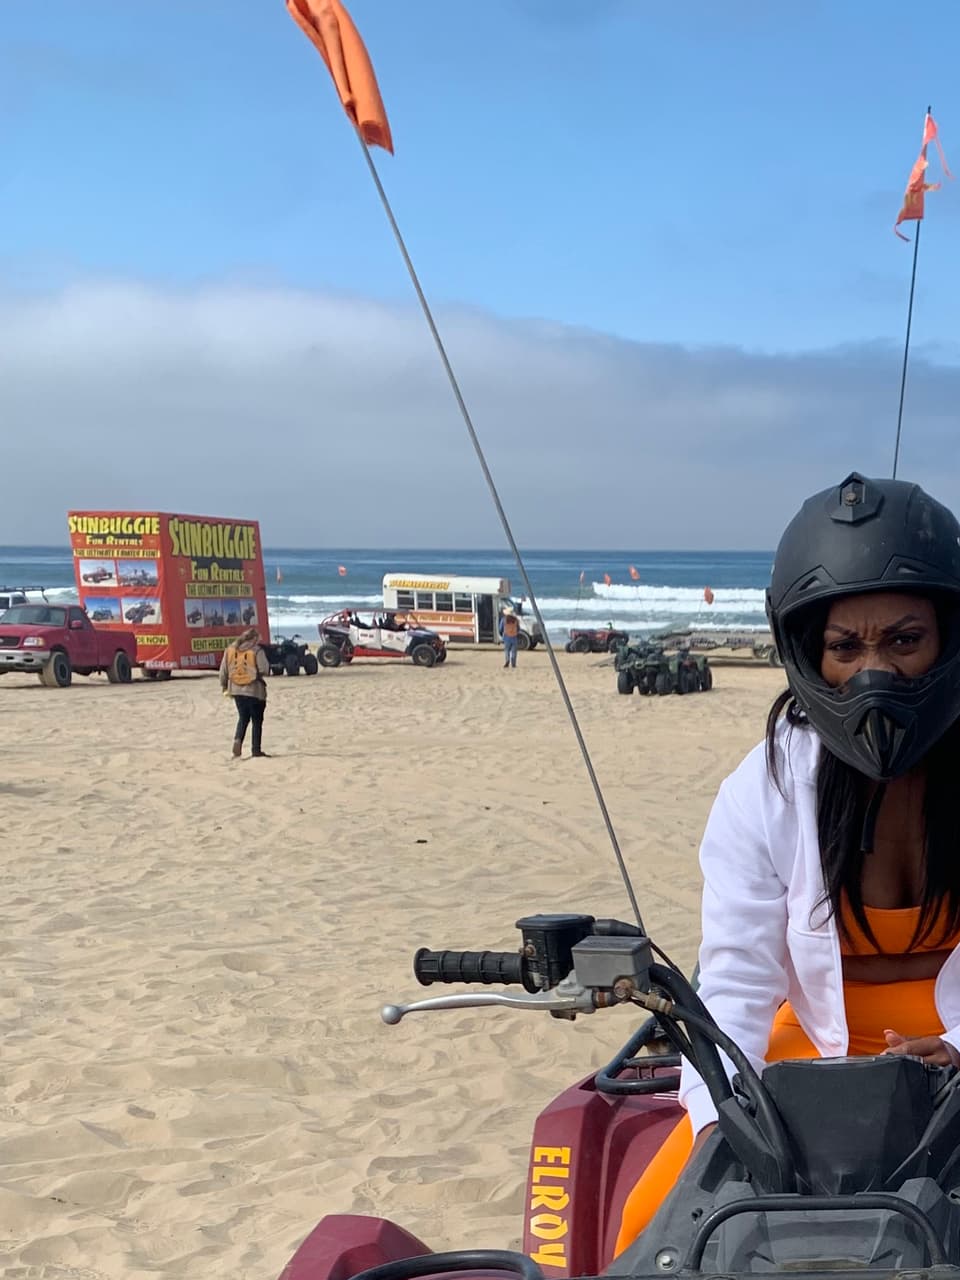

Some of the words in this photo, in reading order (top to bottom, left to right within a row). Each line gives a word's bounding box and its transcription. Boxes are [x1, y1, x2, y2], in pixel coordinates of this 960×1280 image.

[68, 515, 161, 534] SUNBUGGIE
[168, 518, 257, 559] SUNBUGGIE
[529, 1146, 571, 1268] ELROY
